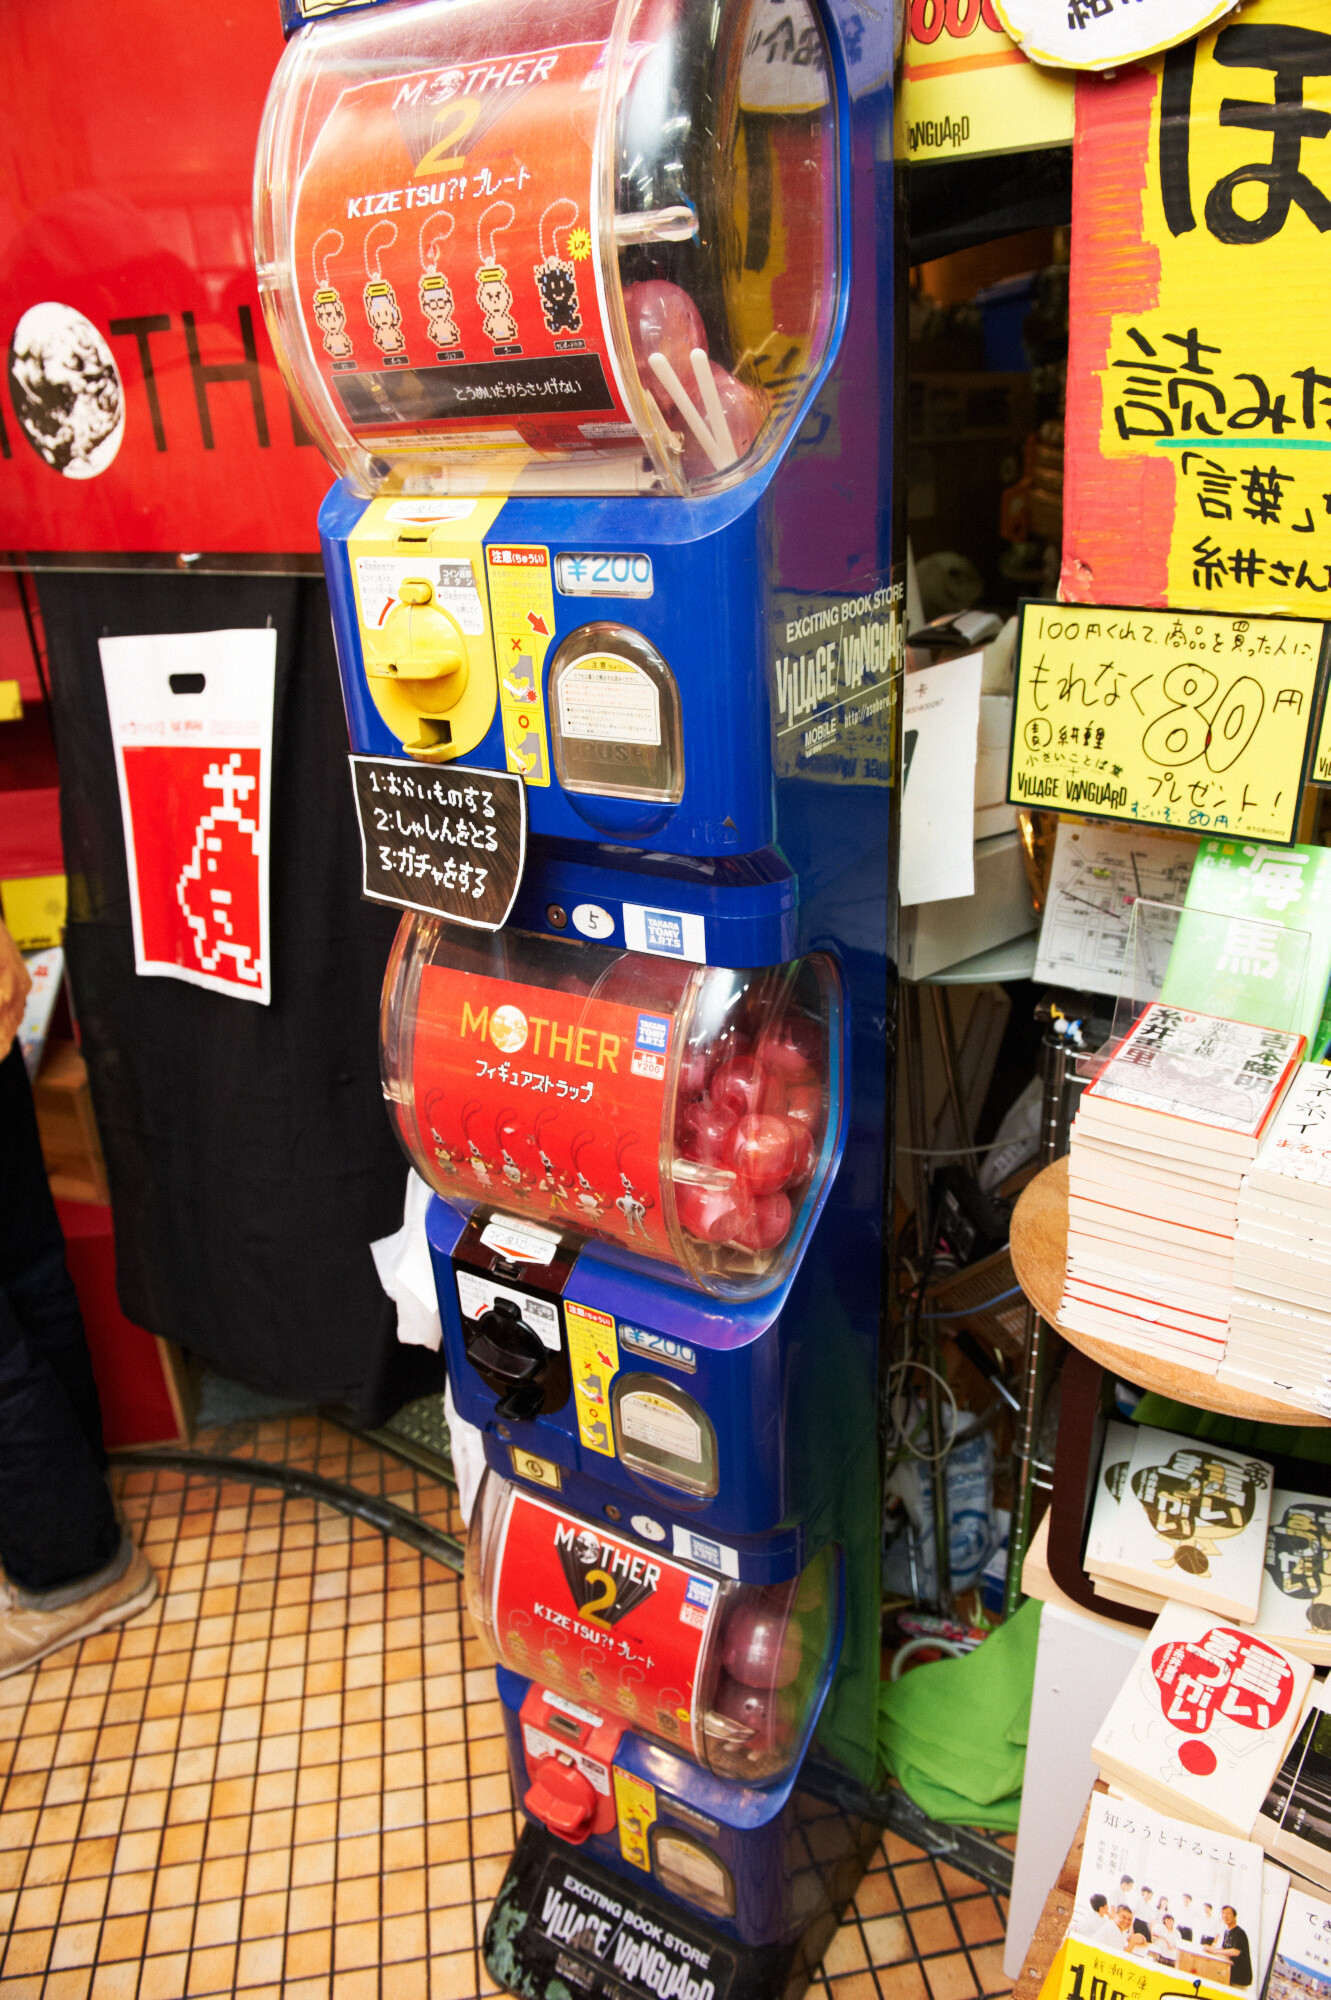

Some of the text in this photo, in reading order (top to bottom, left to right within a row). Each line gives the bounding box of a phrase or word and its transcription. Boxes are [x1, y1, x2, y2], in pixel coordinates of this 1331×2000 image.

[392, 55, 559, 110] MOTHER
[413, 97, 482, 178] 2
[904, 115, 970, 152] ANGUARD
[472, 168, 531, 197] プレート
[454, 378, 582, 401] とうめいだからさりげない
[567, 556, 650, 584] ¥200
[786, 581, 905, 643] EXCITING BOOK STORE
[775, 642, 836, 728] VILLAGE
[1018, 771, 1128, 810] VILLAGE VANGUARD
[588, 910, 599, 930] 5
[648, 926, 681, 939] TOMY
[460, 1001, 620, 1074] MOTHER
[1234, 1031, 1297, 1095] 吉本隆明
[475, 1059, 594, 1103] フィギュアストラップ
[628, 1327, 695, 1363] ¥200
[553, 1521, 662, 1592] MOTHER
[577, 1569, 618, 1631] 2
[1103, 1810, 1248, 1871] 知ろうとすること。
[541, 1886, 716, 2000] VILLAGE VANGUARD
[563, 1874, 711, 1970] EXCITING BOOK STORE
